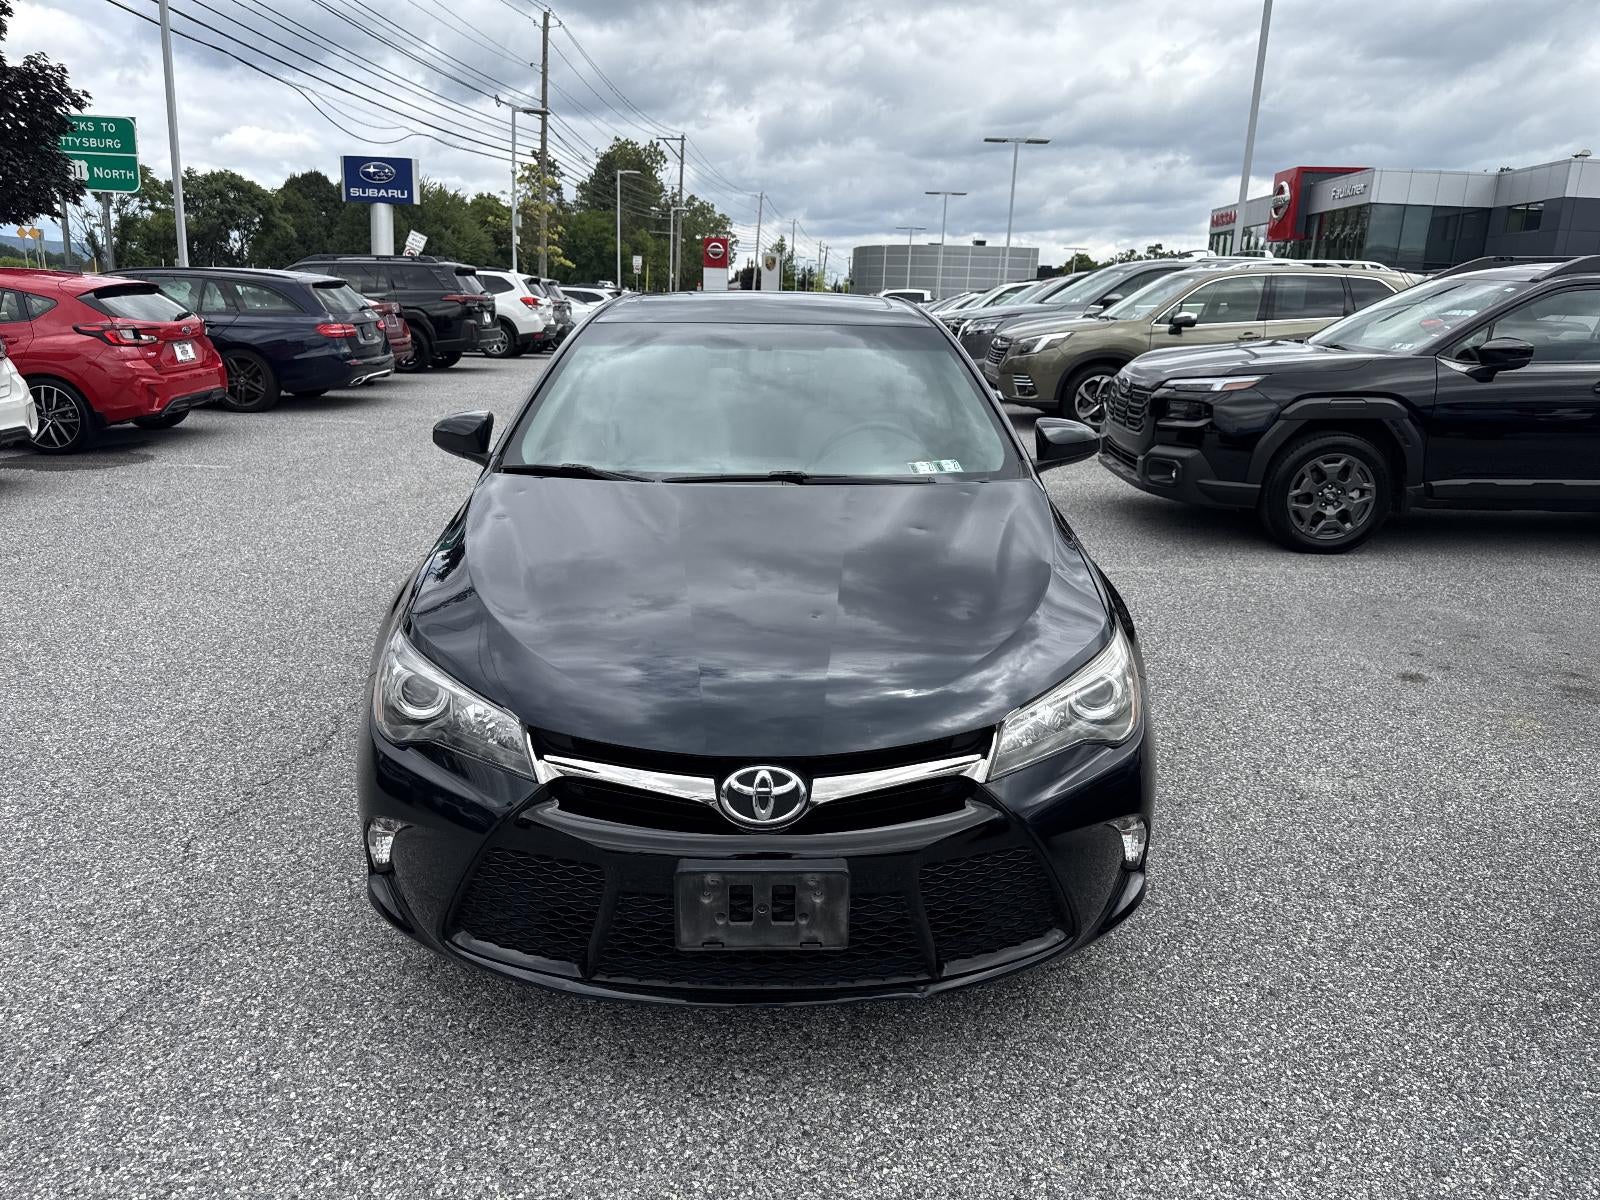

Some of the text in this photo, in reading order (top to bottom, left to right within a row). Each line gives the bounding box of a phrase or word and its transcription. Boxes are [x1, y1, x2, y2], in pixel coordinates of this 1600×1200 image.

[101, 122, 116, 133] TO
[58, 136, 121, 149] TTYSBURG
[93, 166, 135, 180] NORTH
[350, 187, 408, 199] SUBARU
[1331, 183, 1367, 200] Faulkner
